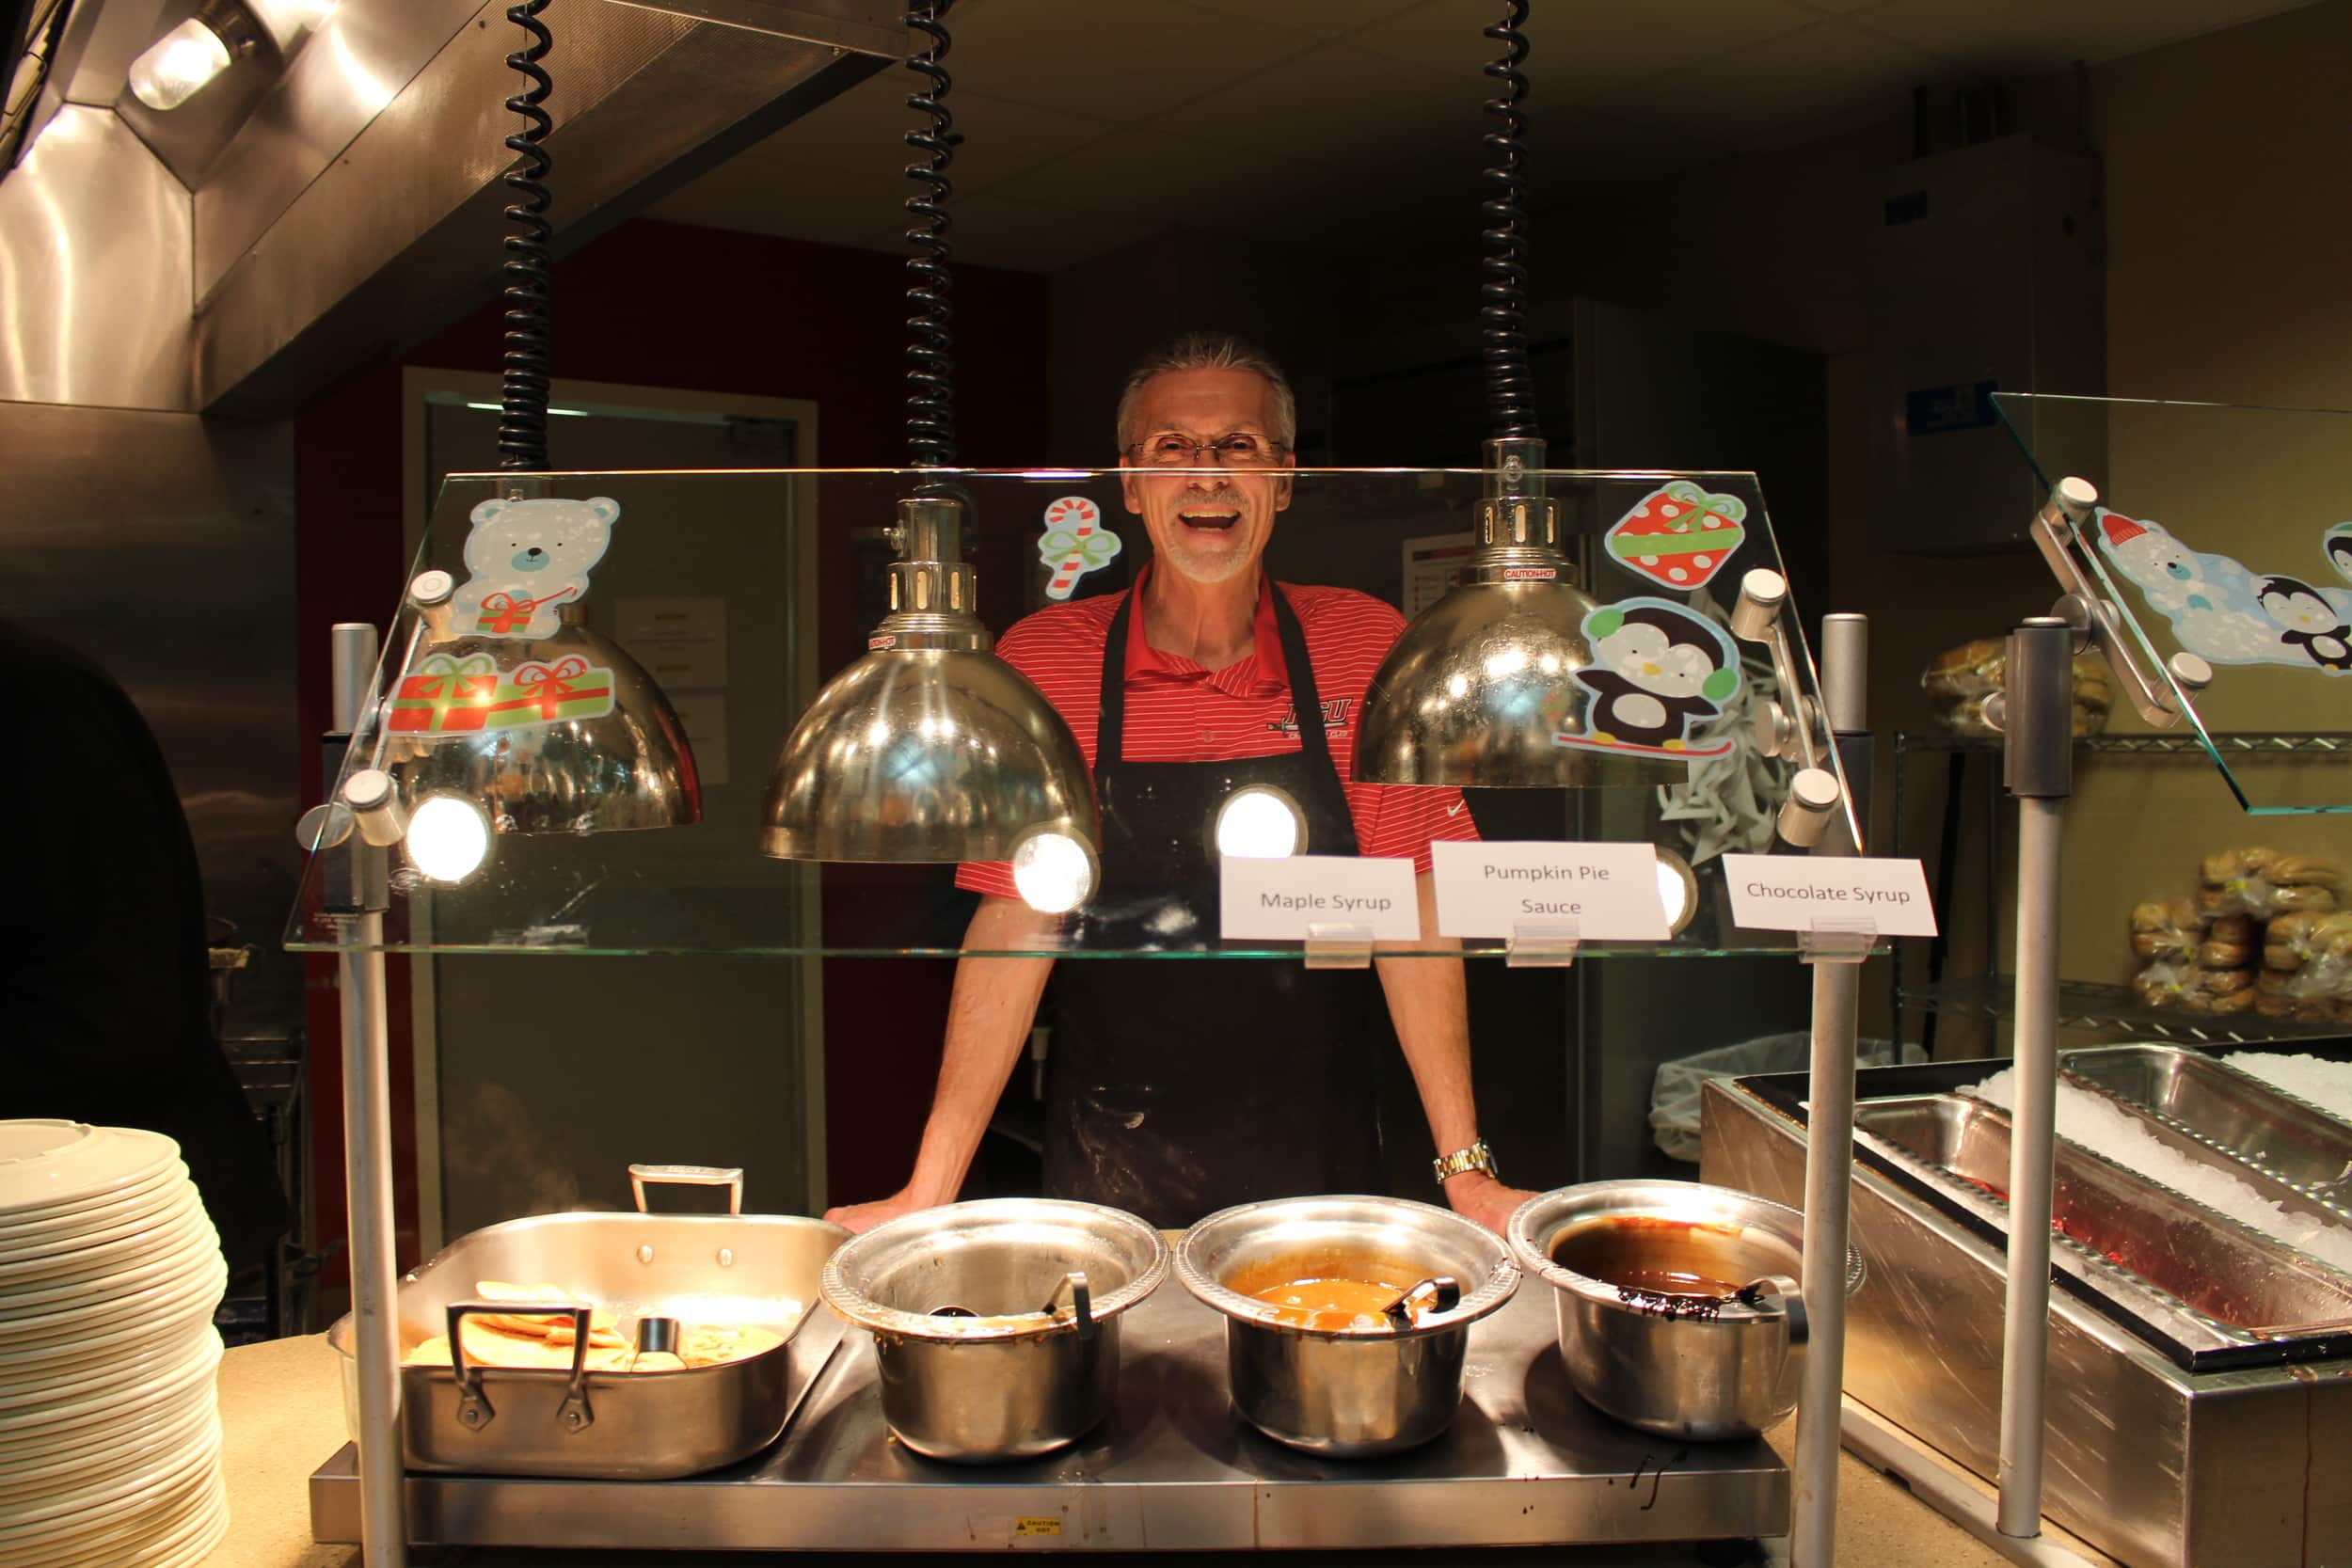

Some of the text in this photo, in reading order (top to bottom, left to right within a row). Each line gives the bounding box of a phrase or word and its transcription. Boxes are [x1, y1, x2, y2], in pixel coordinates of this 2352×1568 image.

[1484, 864, 1610, 882] Pumpkin Pie
[1746, 881, 1911, 905] Chocolate Syrup
[1261, 893, 1391, 912] Maple Syrup
[1521, 898, 1581, 914] Sauce
